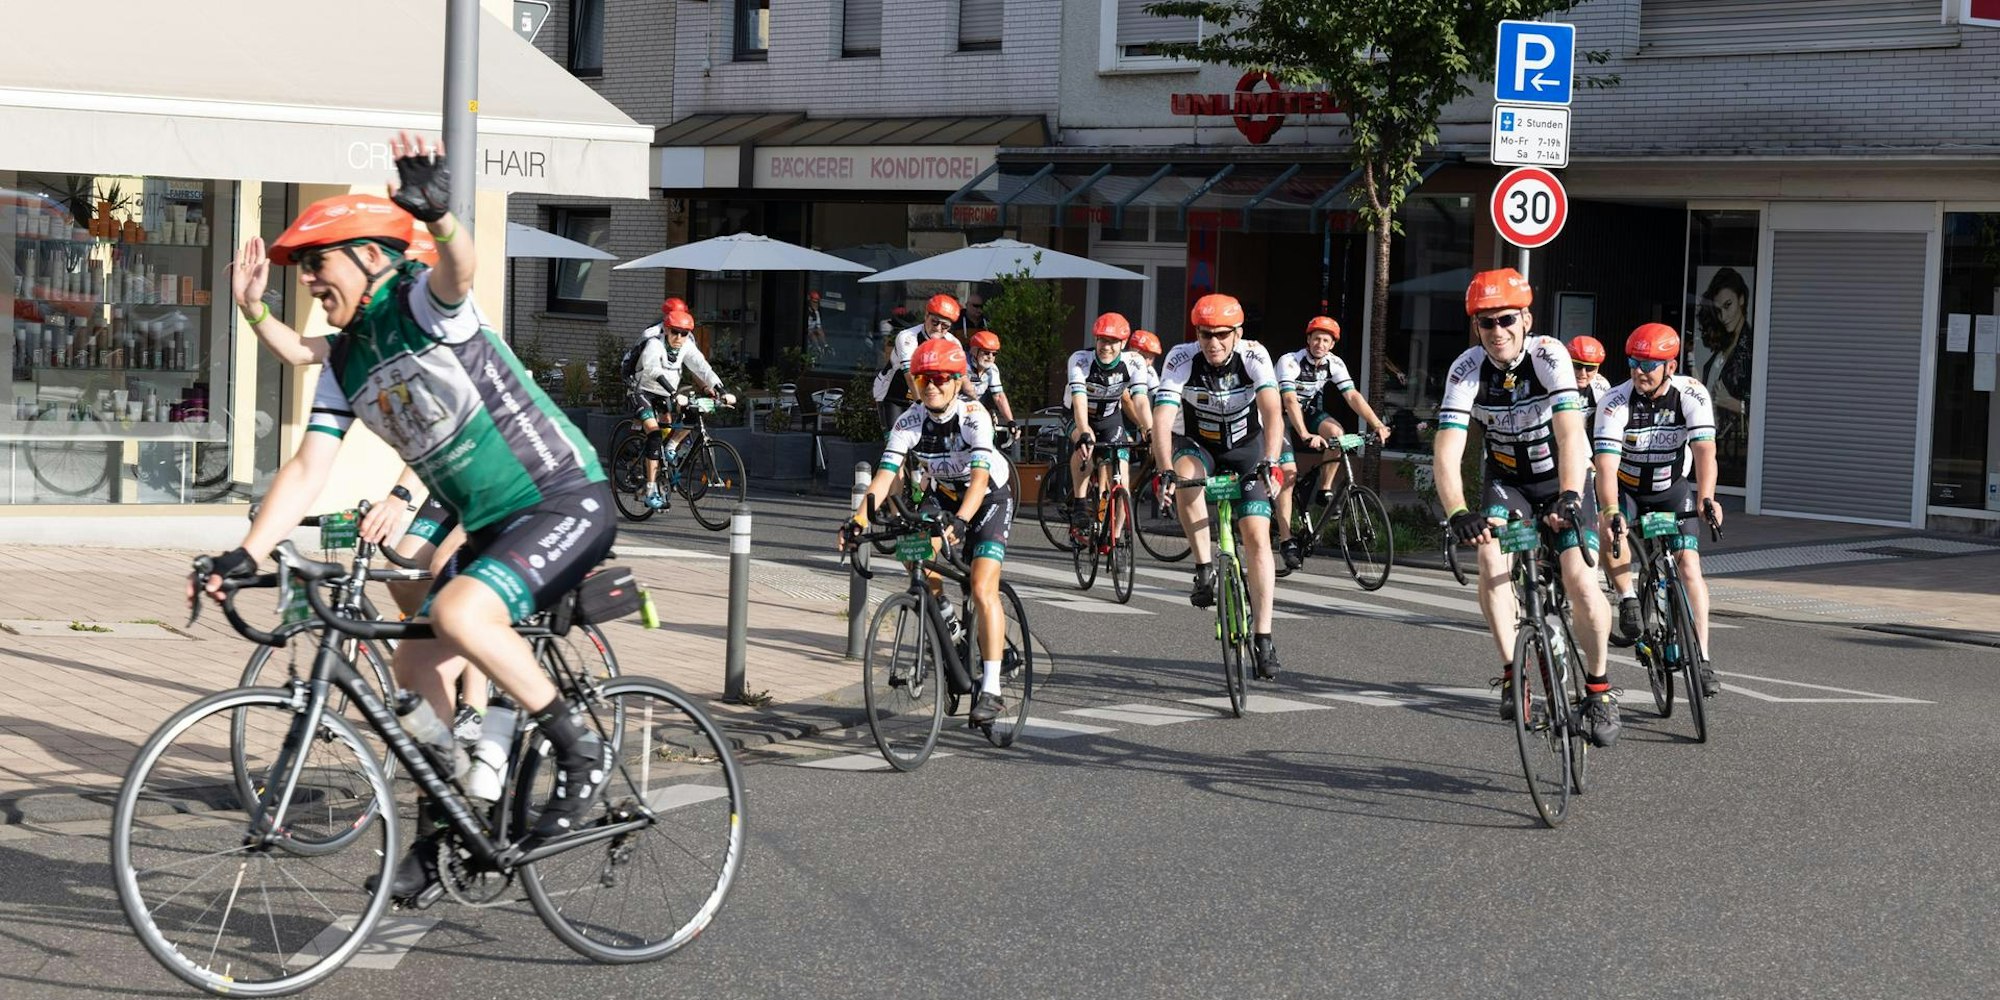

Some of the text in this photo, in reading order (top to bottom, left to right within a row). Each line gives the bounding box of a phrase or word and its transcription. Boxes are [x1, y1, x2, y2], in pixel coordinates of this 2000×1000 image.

[1514, 33, 1555, 91] P
[1517, 119, 1563, 129] 2 Stunden
[1501, 136, 1561, 147] Mo-Fr 7-19h
[1517, 150, 1560, 160] Sa 7-14h
[485, 148, 546, 178] HAIR
[771, 156, 978, 179] BÄCKEREI KONDITOREI
[1509, 190, 1550, 224] 30
[1172, 351, 1189, 366] DFH
[1454, 357, 1476, 376] DFH
[1607, 394, 1626, 409] DFH
[900, 413, 922, 428] DFH
[1639, 432, 1678, 447] SANDER
[351, 678, 482, 835] cannondale
